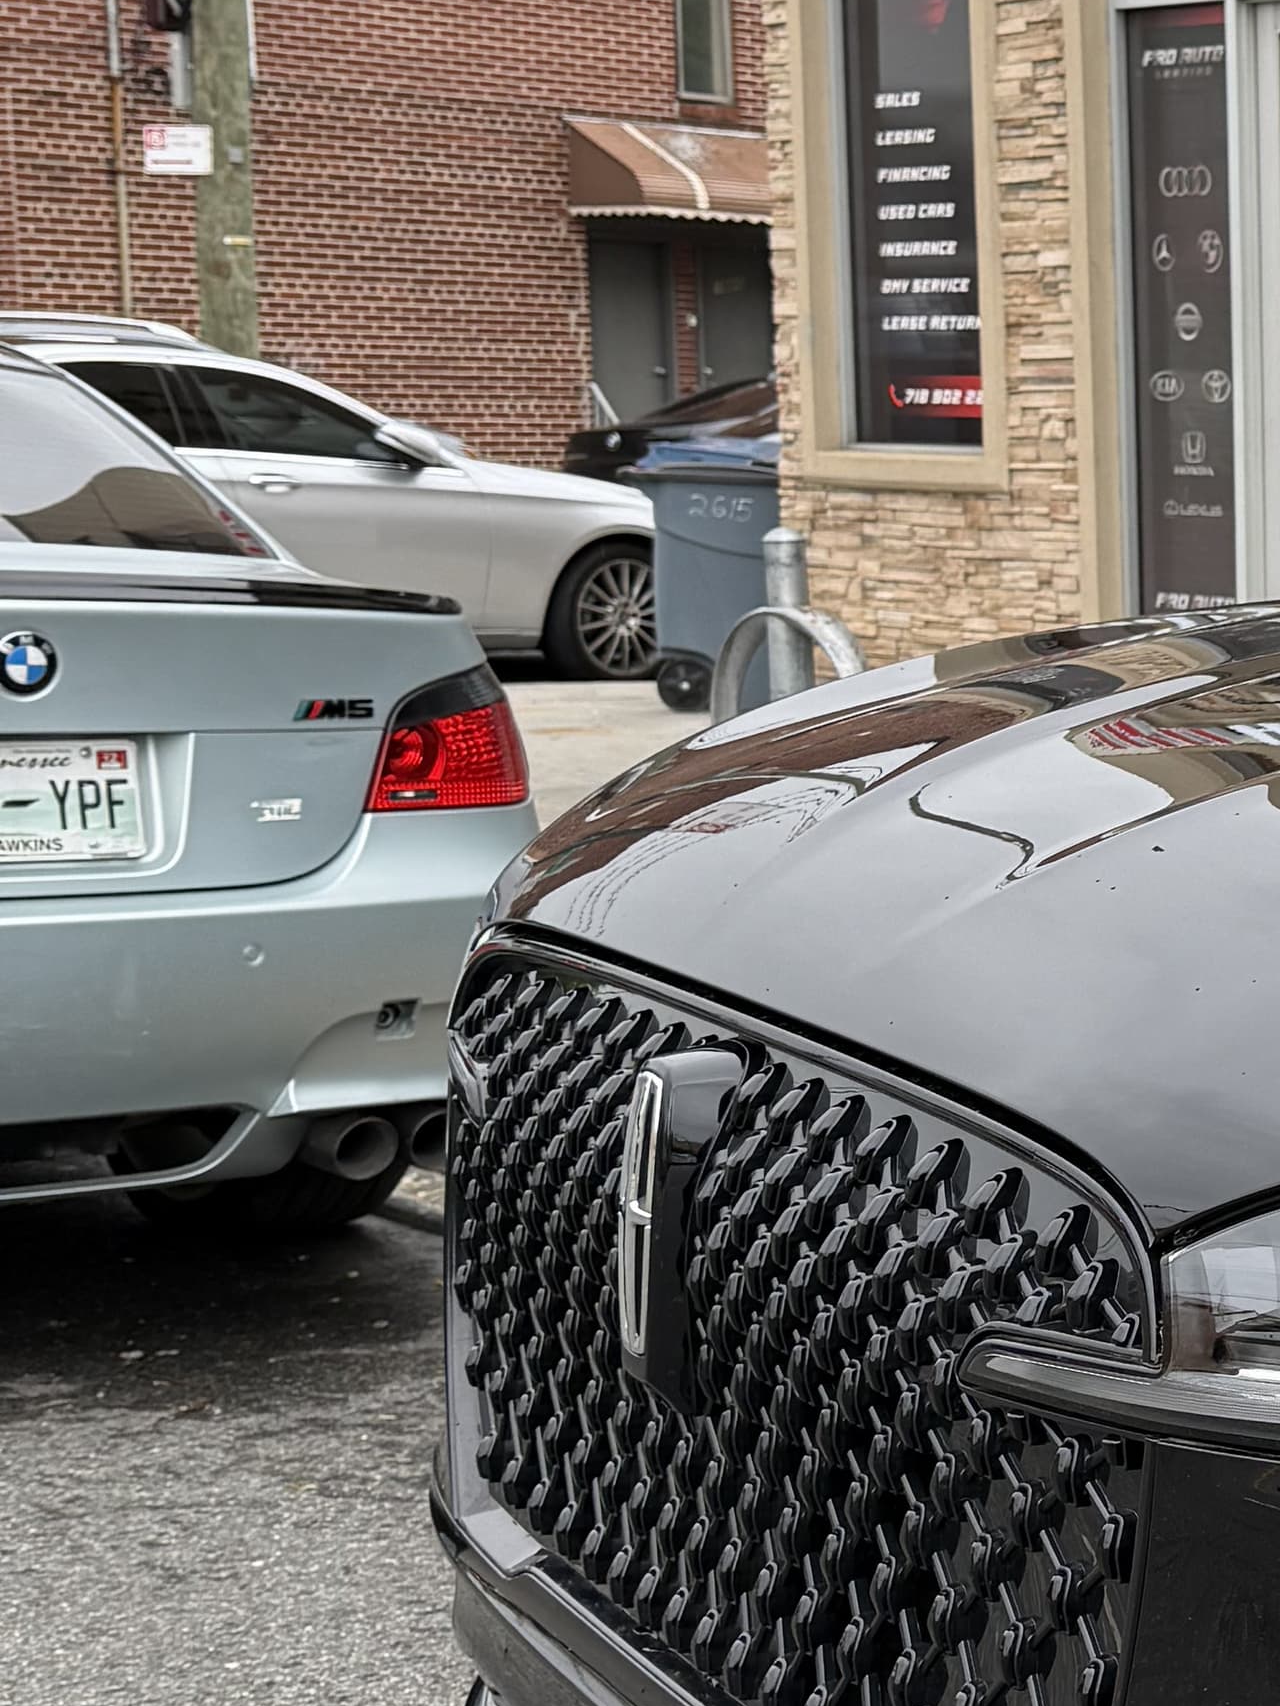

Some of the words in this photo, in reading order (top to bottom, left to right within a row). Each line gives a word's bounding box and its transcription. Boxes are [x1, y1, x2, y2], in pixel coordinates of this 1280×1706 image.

[1142, 49, 1178, 67] PRO
[1179, 45, 1224, 64] AUTO
[874, 92, 920, 109] SALES
[875, 128, 935, 146] LEASING
[877, 165, 951, 183] FINANCING
[878, 204, 916, 220] USED
[918, 202, 955, 219] CARS
[879, 241, 957, 257] INSURANCE
[880, 279, 910, 294] DMV
[911, 278, 970, 293] SERVICE
[882, 315, 927, 331] LEASE
[1156, 377, 1178, 392] KIA
[904, 388, 930, 404] 718
[931, 389, 962, 404] 902
[689, 493, 754, 523] 2615
[322, 699, 373, 719] M5
[0, 837, 63, 852] AWKINS
